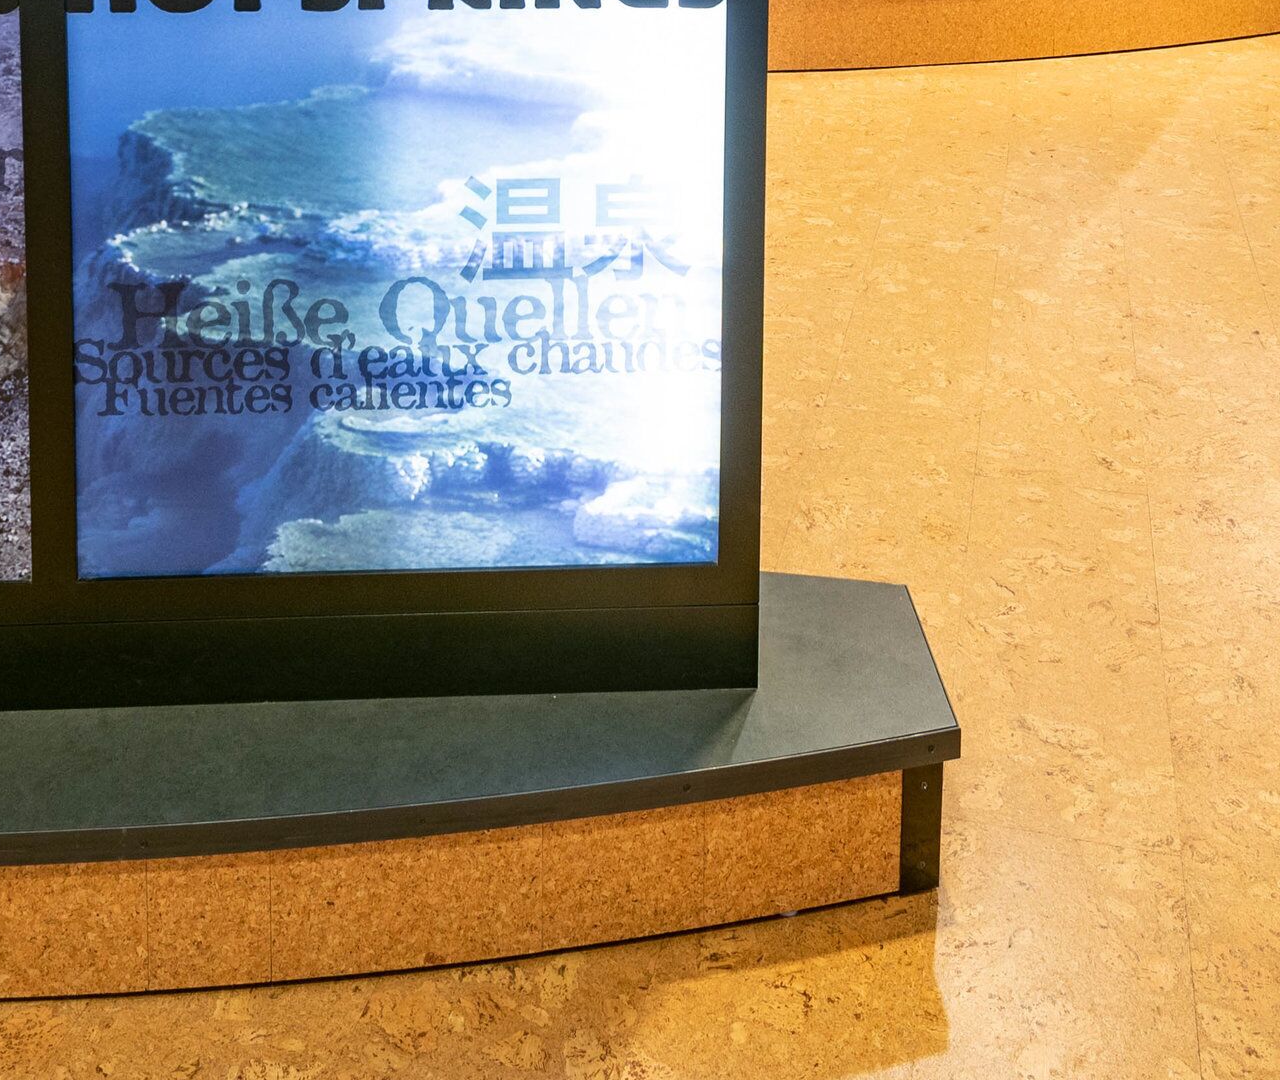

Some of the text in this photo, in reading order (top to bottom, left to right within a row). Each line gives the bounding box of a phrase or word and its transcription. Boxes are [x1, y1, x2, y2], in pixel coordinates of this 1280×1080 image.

[459, 174, 692, 283] 温泉
[106, 276, 692, 349] Heiße Quellen
[74, 338, 291, 384] Sources
[508, 327, 721, 374] chaudes
[98, 375, 511, 416] Fuentes calientes
